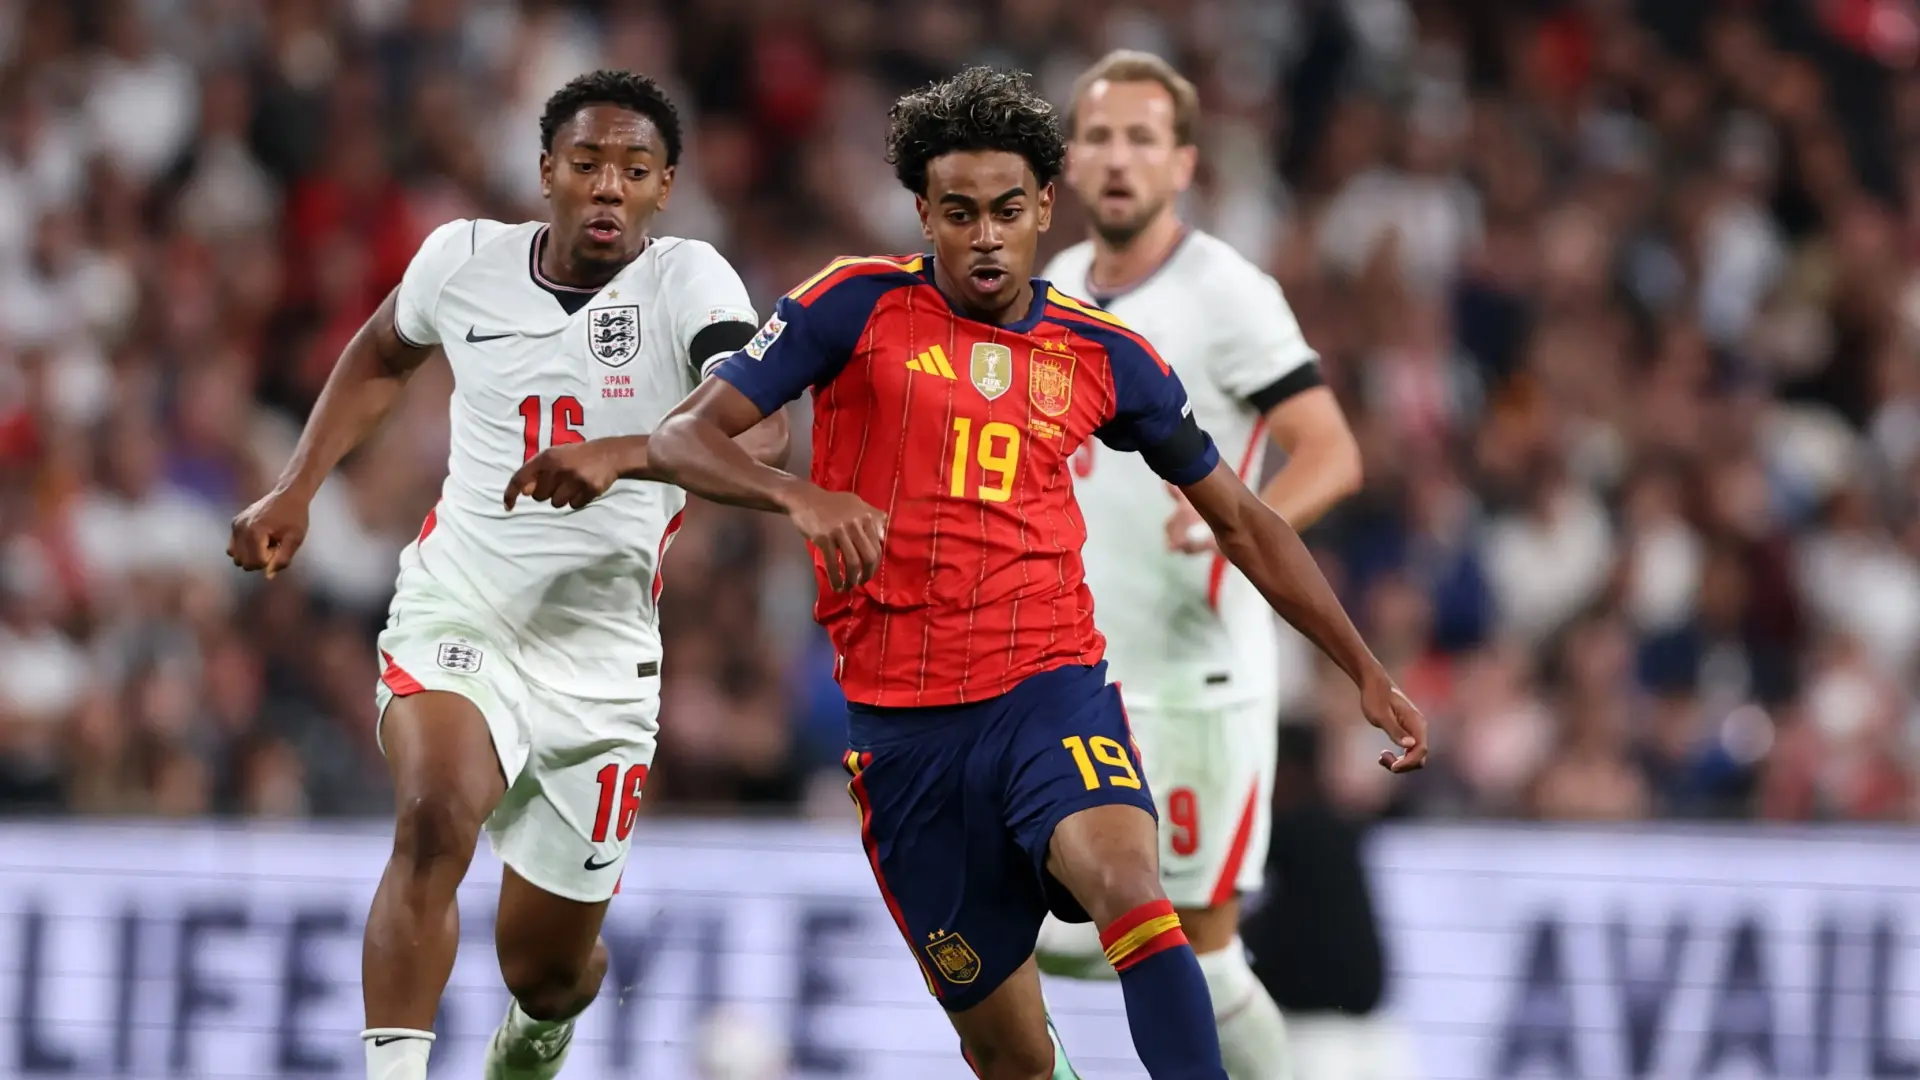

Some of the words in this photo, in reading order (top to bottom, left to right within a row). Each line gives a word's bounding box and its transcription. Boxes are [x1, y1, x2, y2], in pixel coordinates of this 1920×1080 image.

[604, 375, 631, 385] SPAIN
[982, 377, 1001, 389] FIFA
[519, 395, 586, 465] 16
[951, 417, 1020, 502] 19
[1062, 735, 1142, 791] 19
[591, 763, 650, 843] 16
[1168, 786, 1199, 856] 9
[16, 906, 864, 1075] LIFEYLE
